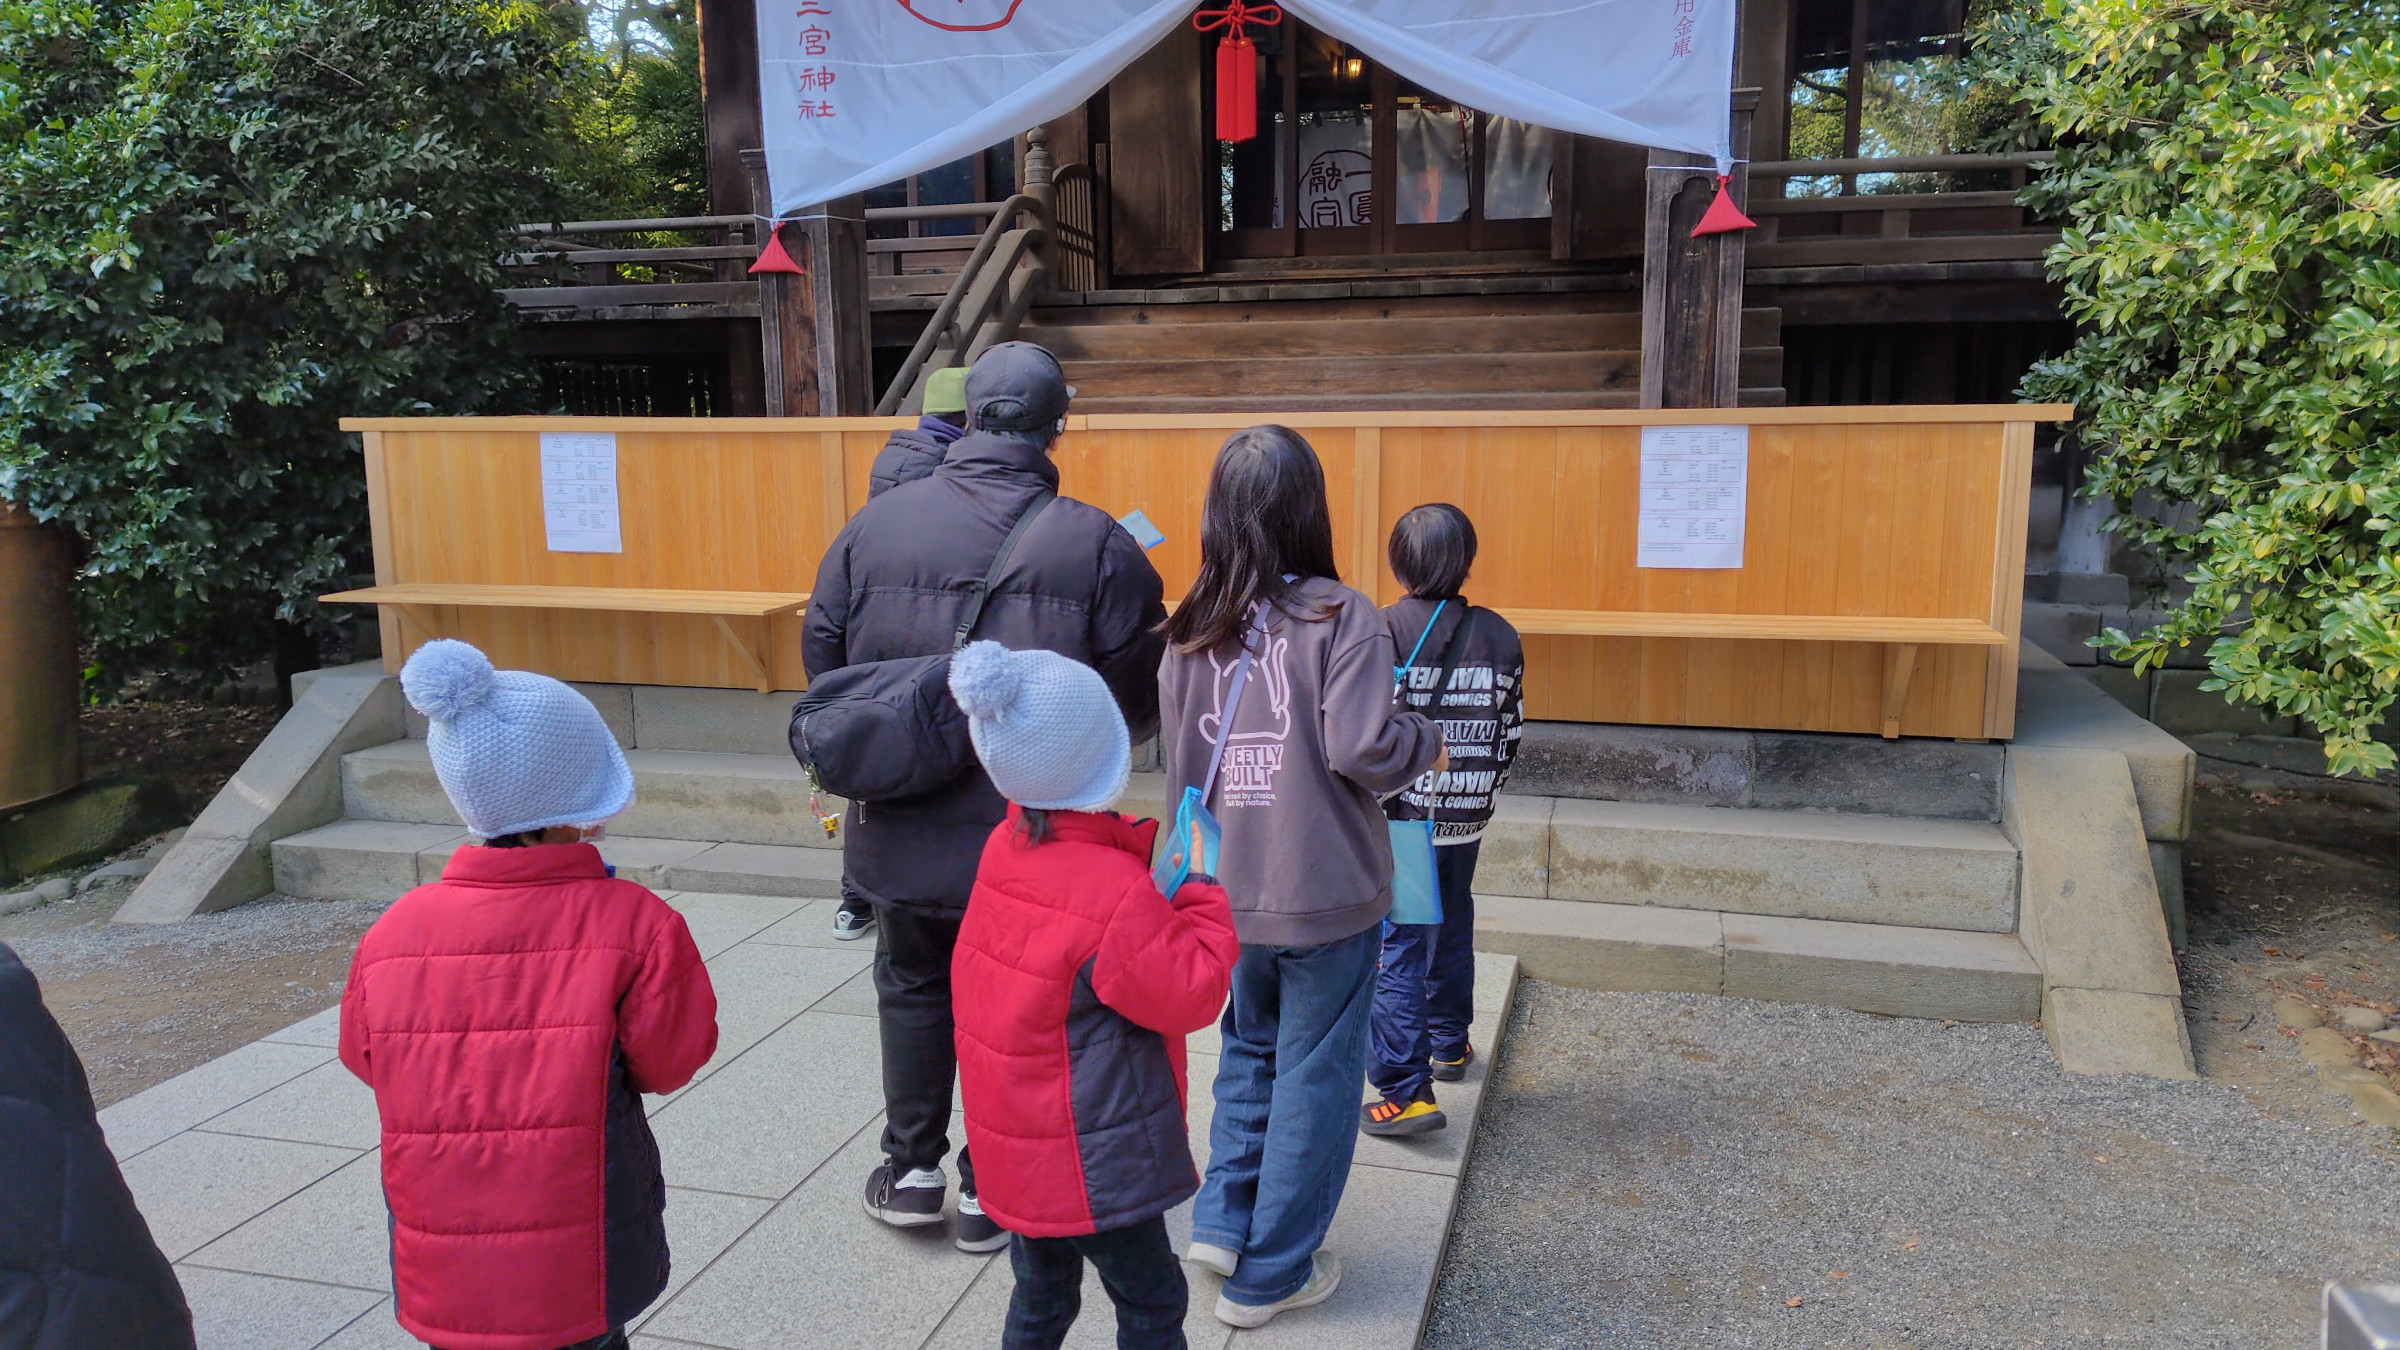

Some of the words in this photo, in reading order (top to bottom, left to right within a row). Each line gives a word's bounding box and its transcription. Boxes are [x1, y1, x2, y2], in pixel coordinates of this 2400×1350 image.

[1440, 692, 1492, 707] COMICS
[1221, 746, 1283, 769] SWEETLY
[1226, 766, 1272, 790] BUILT
[1444, 795, 1489, 810] COMICS
